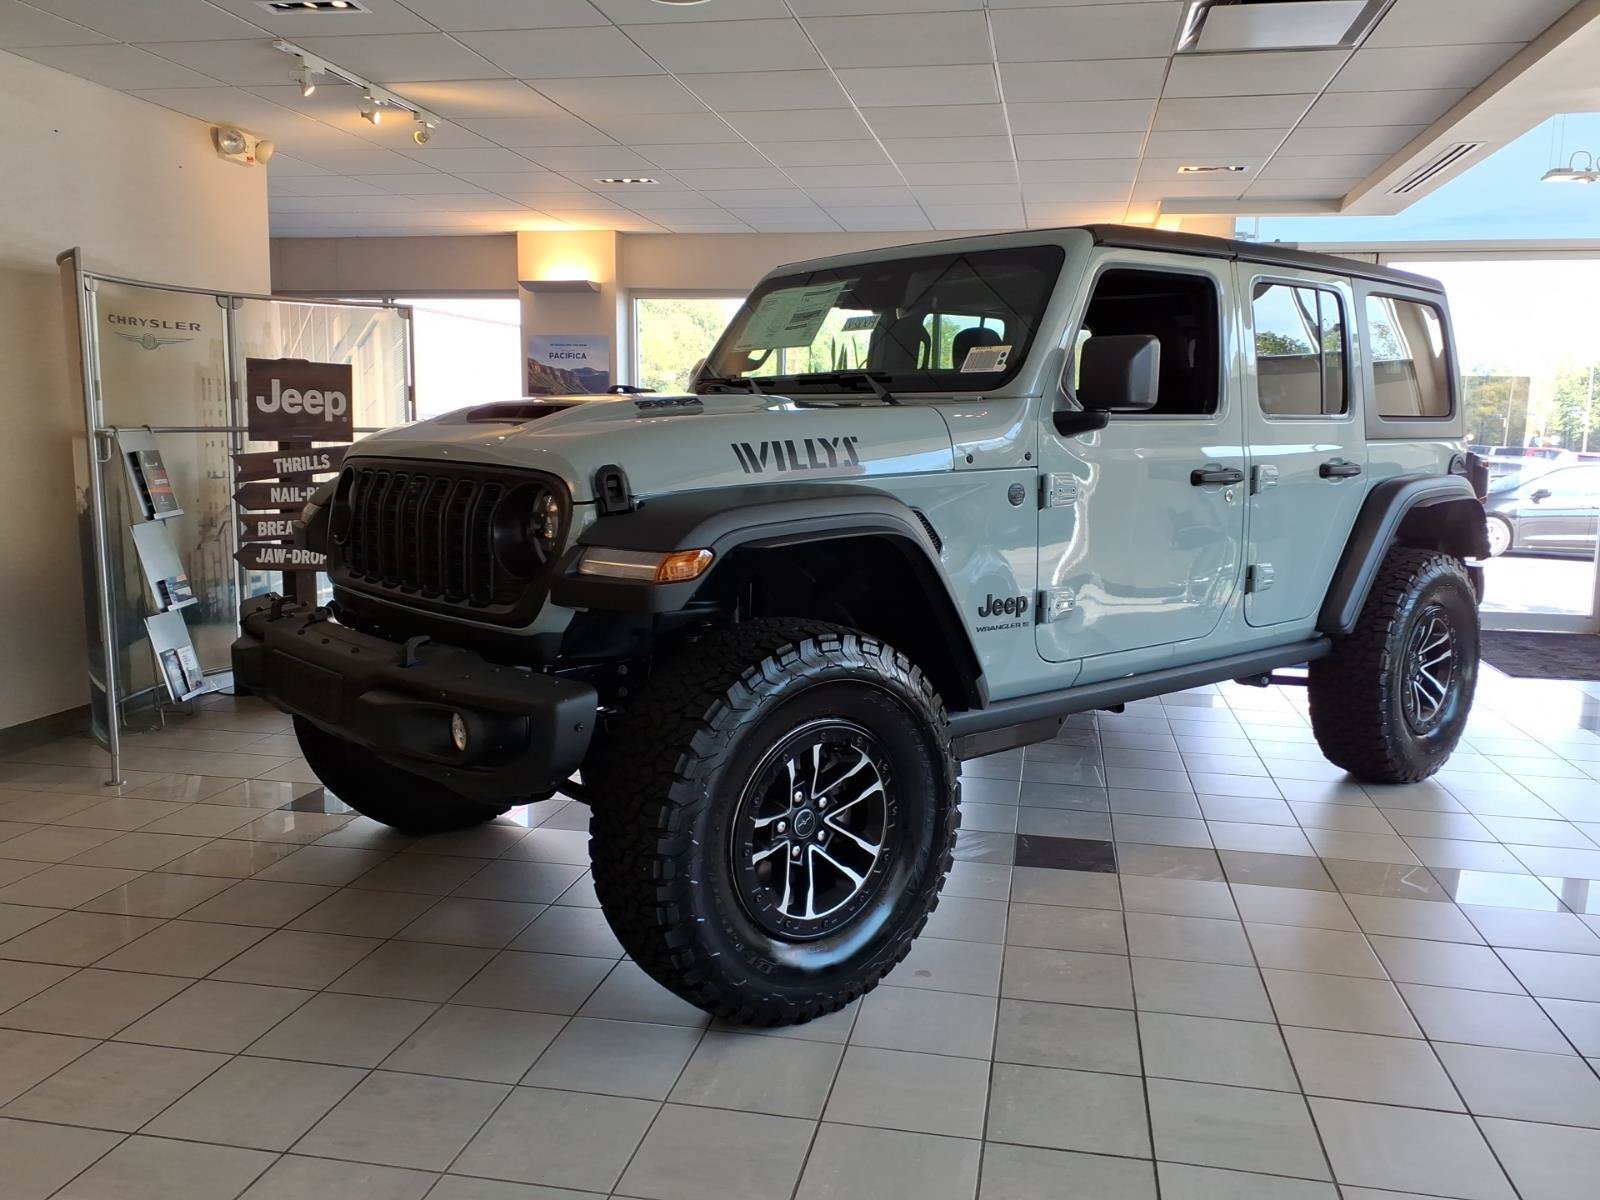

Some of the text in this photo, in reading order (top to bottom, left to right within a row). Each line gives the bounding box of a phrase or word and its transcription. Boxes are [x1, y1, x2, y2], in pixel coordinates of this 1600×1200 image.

[108, 314, 201, 332] CHRYSLER
[548, 352, 587, 360] PACIFICA
[255, 378, 347, 422] Jeep
[273, 454, 331, 474] THRILLS
[730, 436, 859, 474] WILLYS
[978, 594, 1028, 618] Jeep
[976, 621, 1021, 633] WRANGLER
